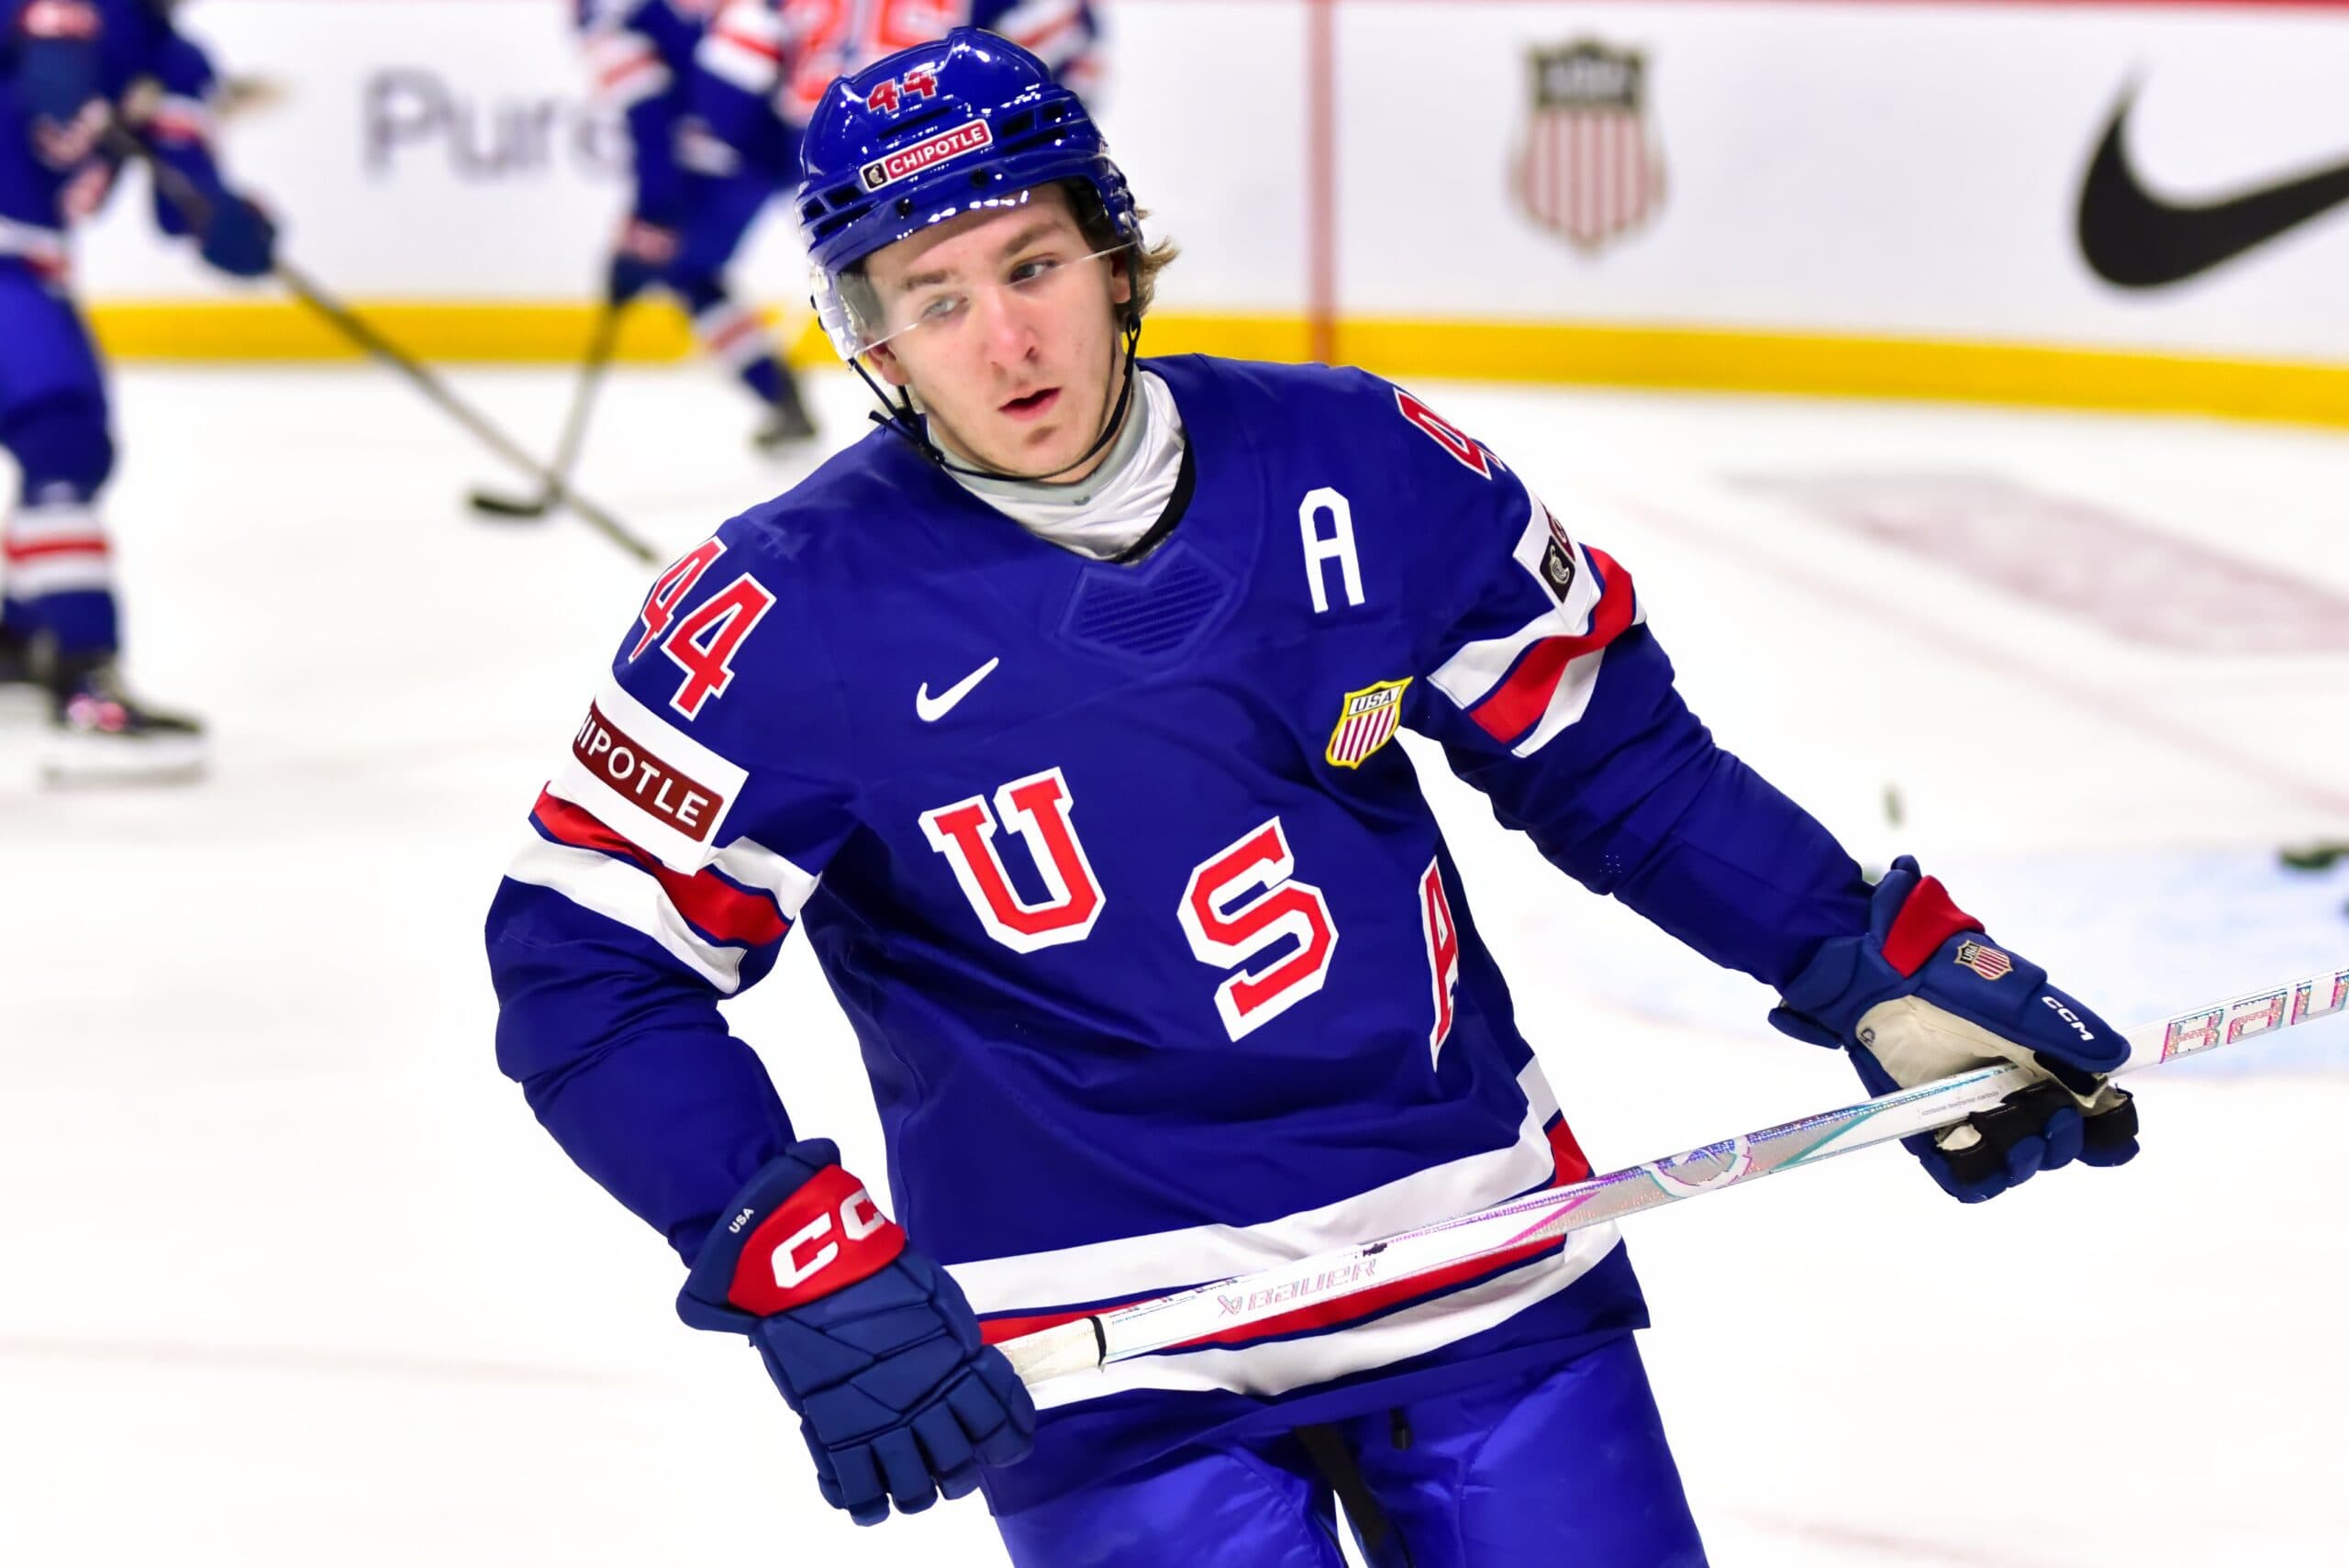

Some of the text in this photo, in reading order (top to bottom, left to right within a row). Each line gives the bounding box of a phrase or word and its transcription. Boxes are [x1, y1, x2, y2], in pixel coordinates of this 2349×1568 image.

[866, 62, 938, 114] 44
[889, 126, 985, 173] CHIPOTLE
[1298, 486, 1365, 614] A
[628, 535, 777, 722] 44
[1354, 689, 1392, 713] USA
[2041, 995, 2095, 1041] CCM
[728, 1207, 754, 1234] USA
